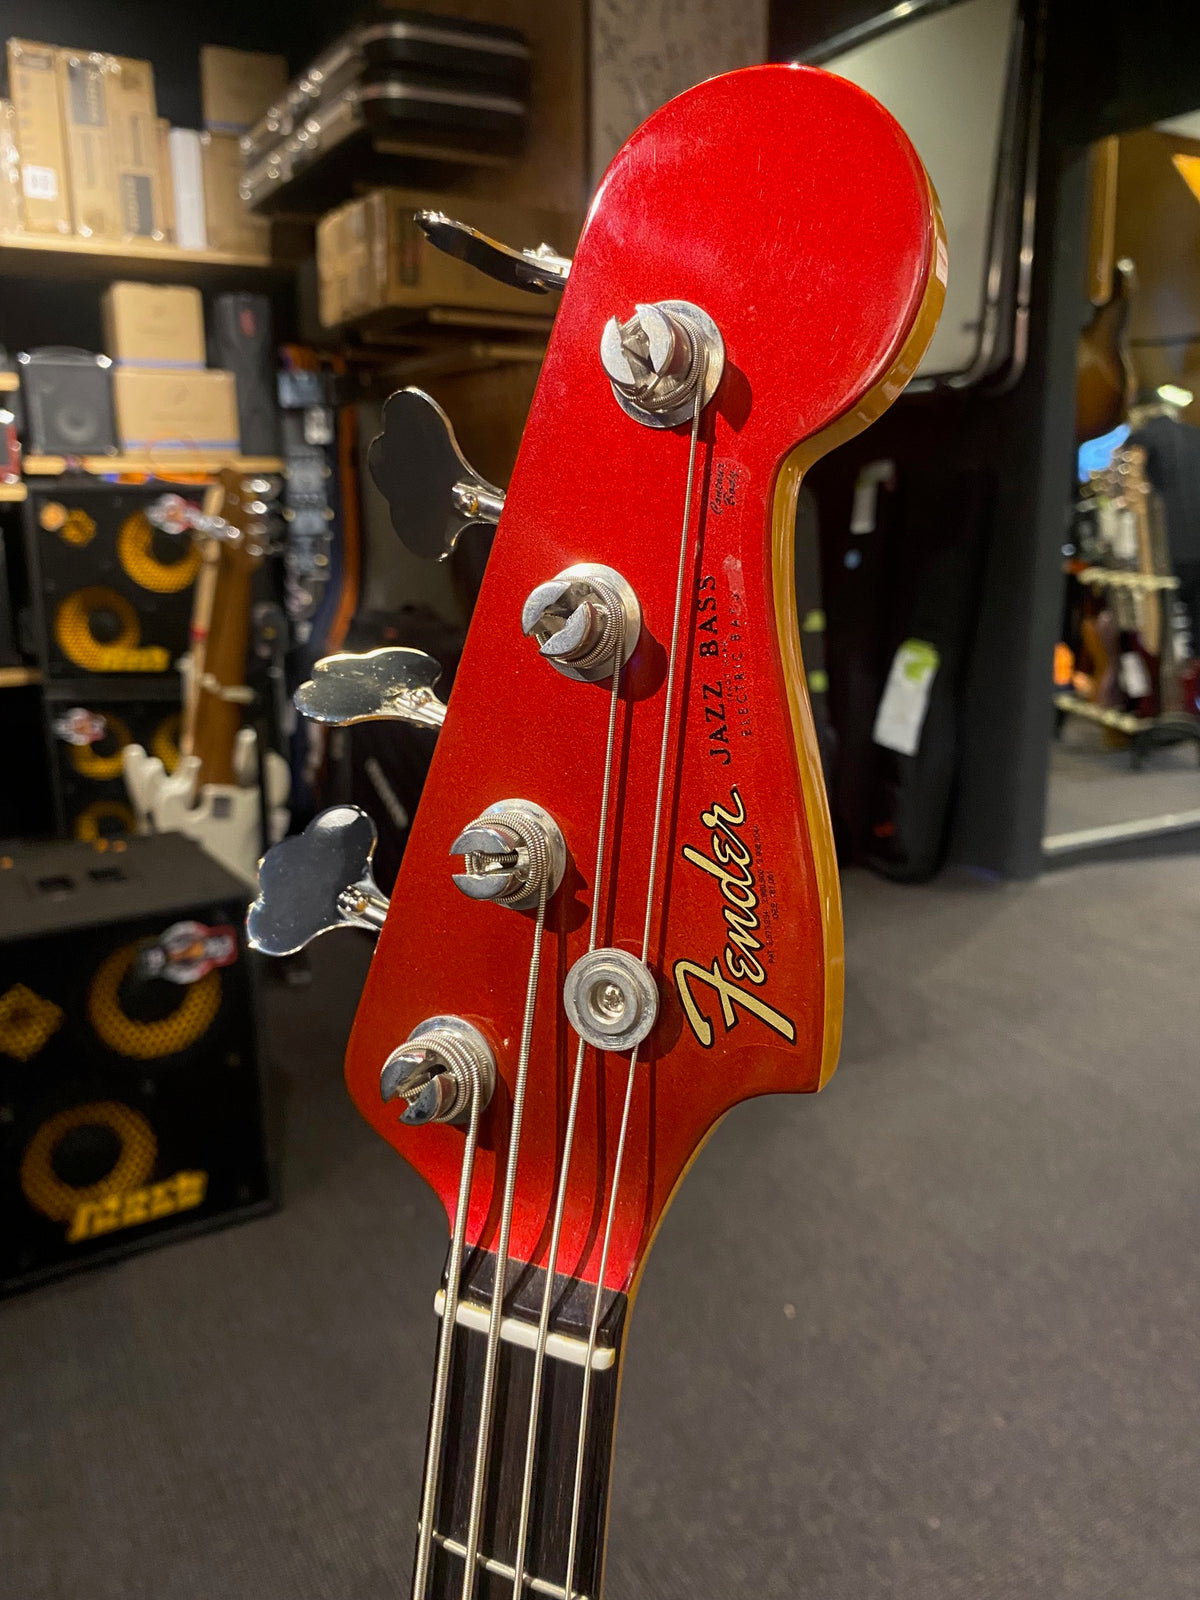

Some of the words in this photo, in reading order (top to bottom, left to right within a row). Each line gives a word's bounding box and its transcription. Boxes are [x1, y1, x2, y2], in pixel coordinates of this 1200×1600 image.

[696, 575, 719, 657] BASS
[703, 681, 731, 766] JAZZ
[732, 652, 752, 737] ELECTRIC
[673, 787, 797, 1049] Fender
